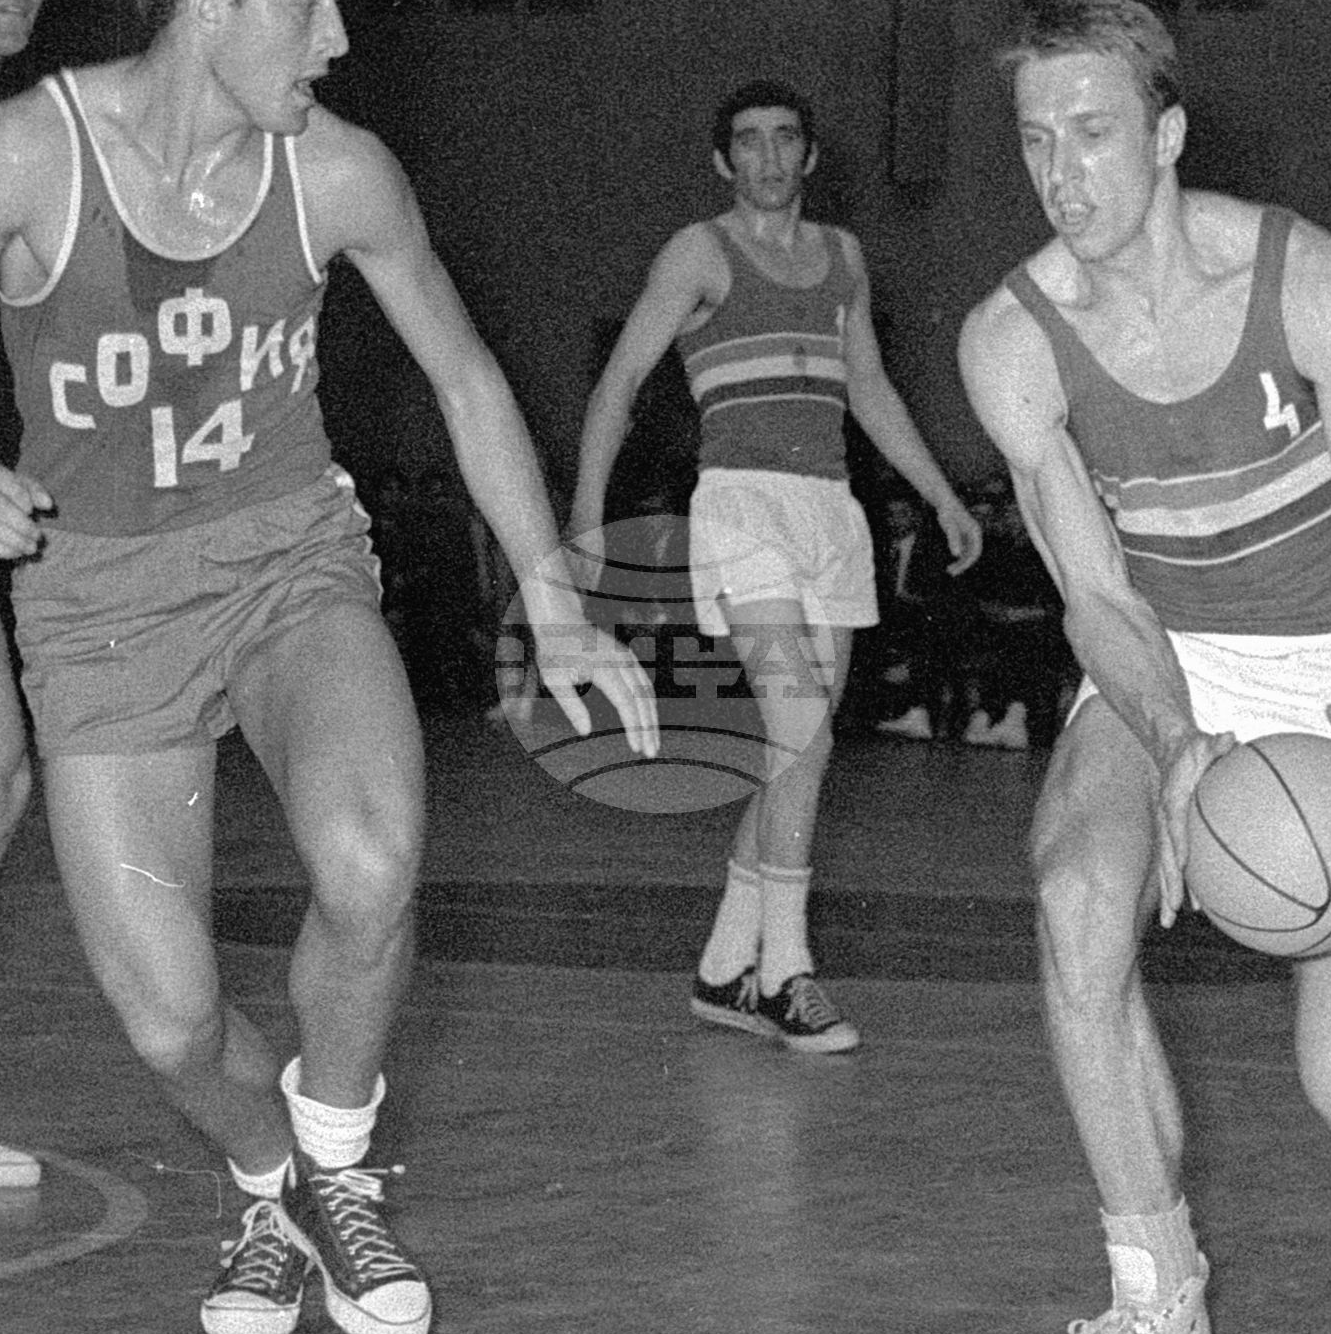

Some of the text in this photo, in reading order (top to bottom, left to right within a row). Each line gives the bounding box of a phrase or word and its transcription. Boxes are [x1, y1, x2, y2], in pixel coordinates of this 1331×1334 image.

[49, 287, 316, 430] СОФИЯ
[151, 398, 256, 488] 14
[1258, 372, 1302, 438] 4
